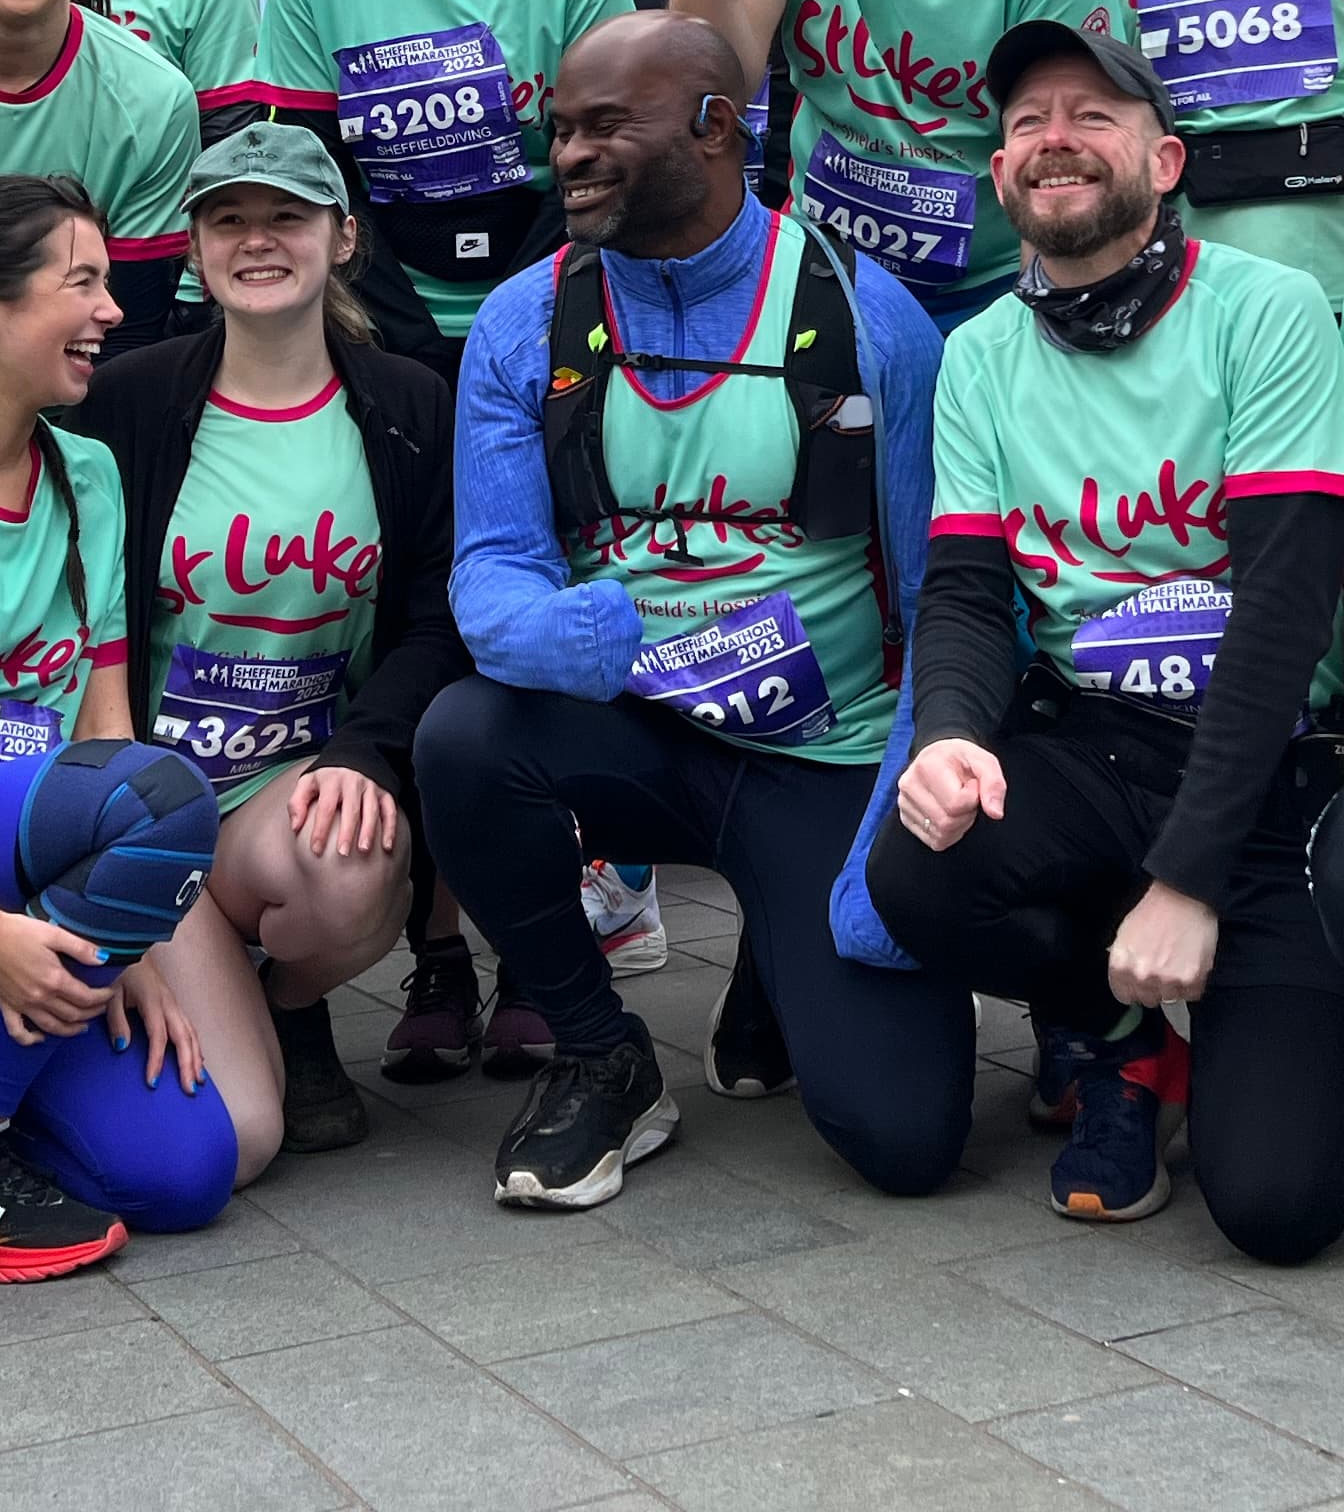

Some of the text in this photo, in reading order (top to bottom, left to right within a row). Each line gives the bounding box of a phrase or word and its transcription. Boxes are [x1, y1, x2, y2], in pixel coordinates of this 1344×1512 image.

[794, 0, 849, 78] St
[1178, 3, 1302, 54] 5068
[376, 40, 432, 59] SHEFFIELD
[378, 41, 480, 70] HALF MARATHON
[443, 53, 485, 74] 2023
[370, 86, 485, 140] 3208
[376, 126, 492, 156] SHEFFIELDDIVING
[492, 165, 526, 184] 3208
[850, 160, 907, 183] SHEFFIELD
[849, 172, 955, 202] HALF MARATHON
[911, 199, 955, 218] 2023
[827, 206, 943, 265] 4027
[1140, 582, 1211, 600] SHEFFIELD
[1140, 599, 1178, 614] HALF
[660, 631, 719, 659] SHEFFIELD
[664, 619, 777, 673] HALF MARATHON
[737, 635, 786, 665] 2023
[233, 670, 334, 691] HALF MARATHON
[234, 666, 297, 678] SHEFFIELD
[294, 685, 329, 702] 2023
[191, 716, 312, 759] 3625
